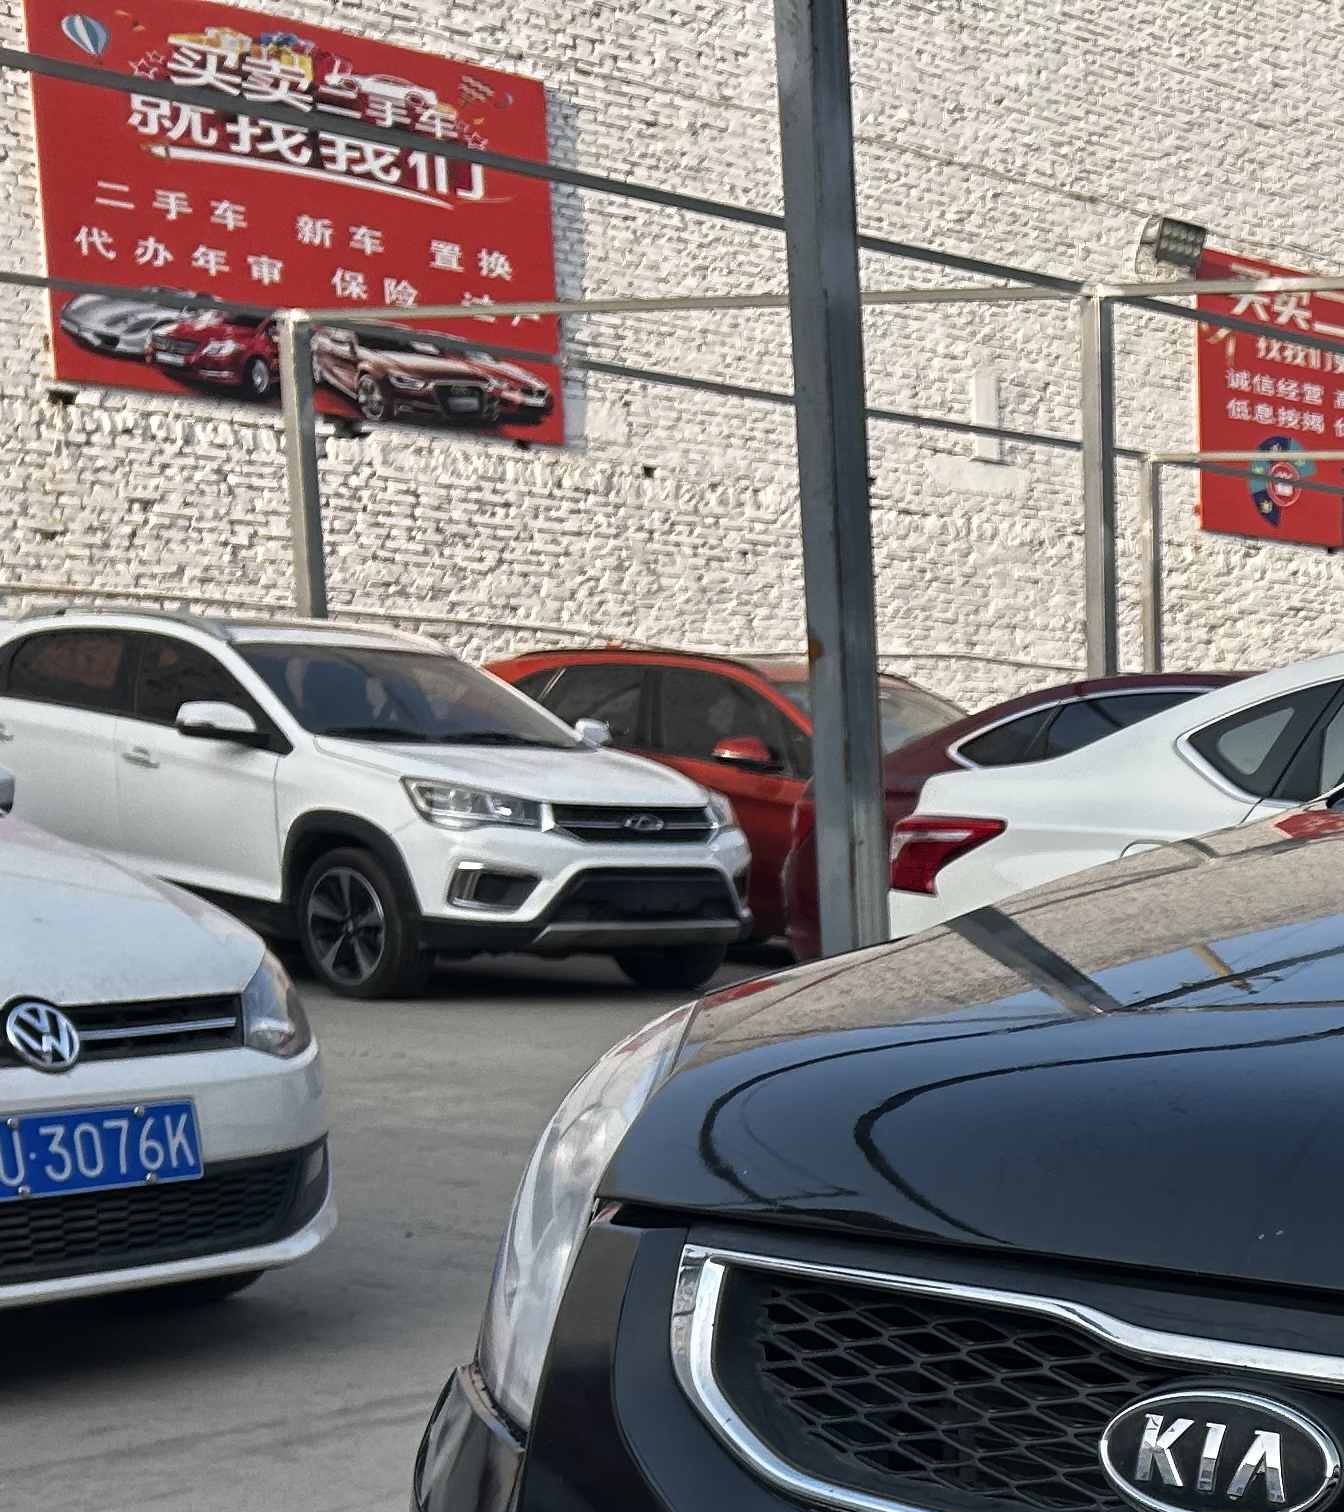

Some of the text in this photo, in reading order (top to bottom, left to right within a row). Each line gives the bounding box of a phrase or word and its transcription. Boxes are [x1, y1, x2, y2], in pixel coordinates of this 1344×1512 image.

[167, 36, 460, 140] 买卖二手车
[127, 93, 486, 200] 就找我们
[74, 226, 419, 308] 代办年审 保险
[95, 180, 514, 282] 二手车 新车 置换
[1225, 368, 1325, 405] 诚信经营
[1134, 1413, 1286, 1503] KIA
